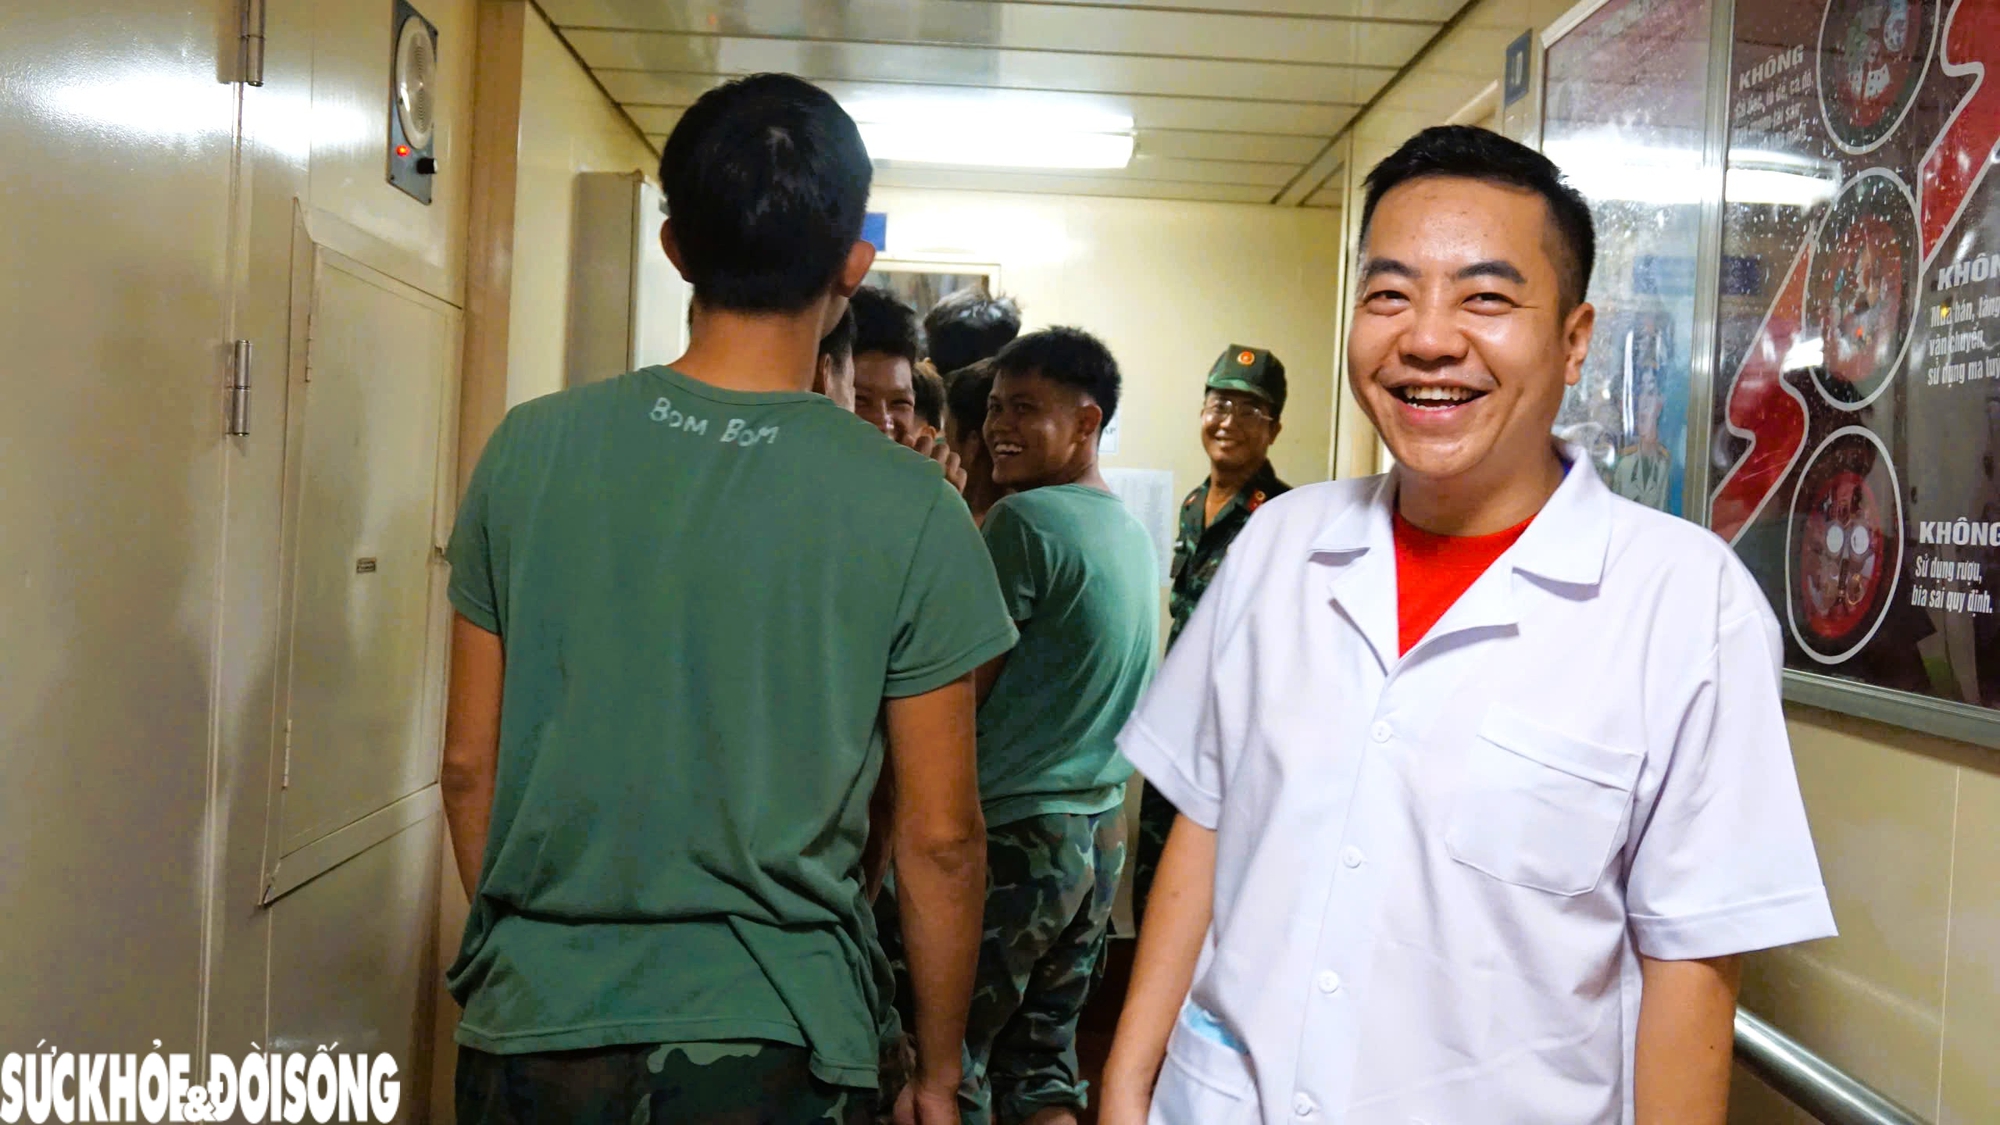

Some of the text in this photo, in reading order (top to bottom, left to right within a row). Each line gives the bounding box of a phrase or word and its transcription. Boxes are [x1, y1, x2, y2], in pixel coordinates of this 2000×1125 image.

[1738, 43, 1804, 91] KHÔNG
[1954, 299, 1975, 323] bán,
[1942, 362, 1965, 388] dụng
[1968, 360, 1984, 380] ma
[1915, 553, 1982, 586] Sử dụng rượu,
[1911, 584, 1993, 617] bia sai quy định.
